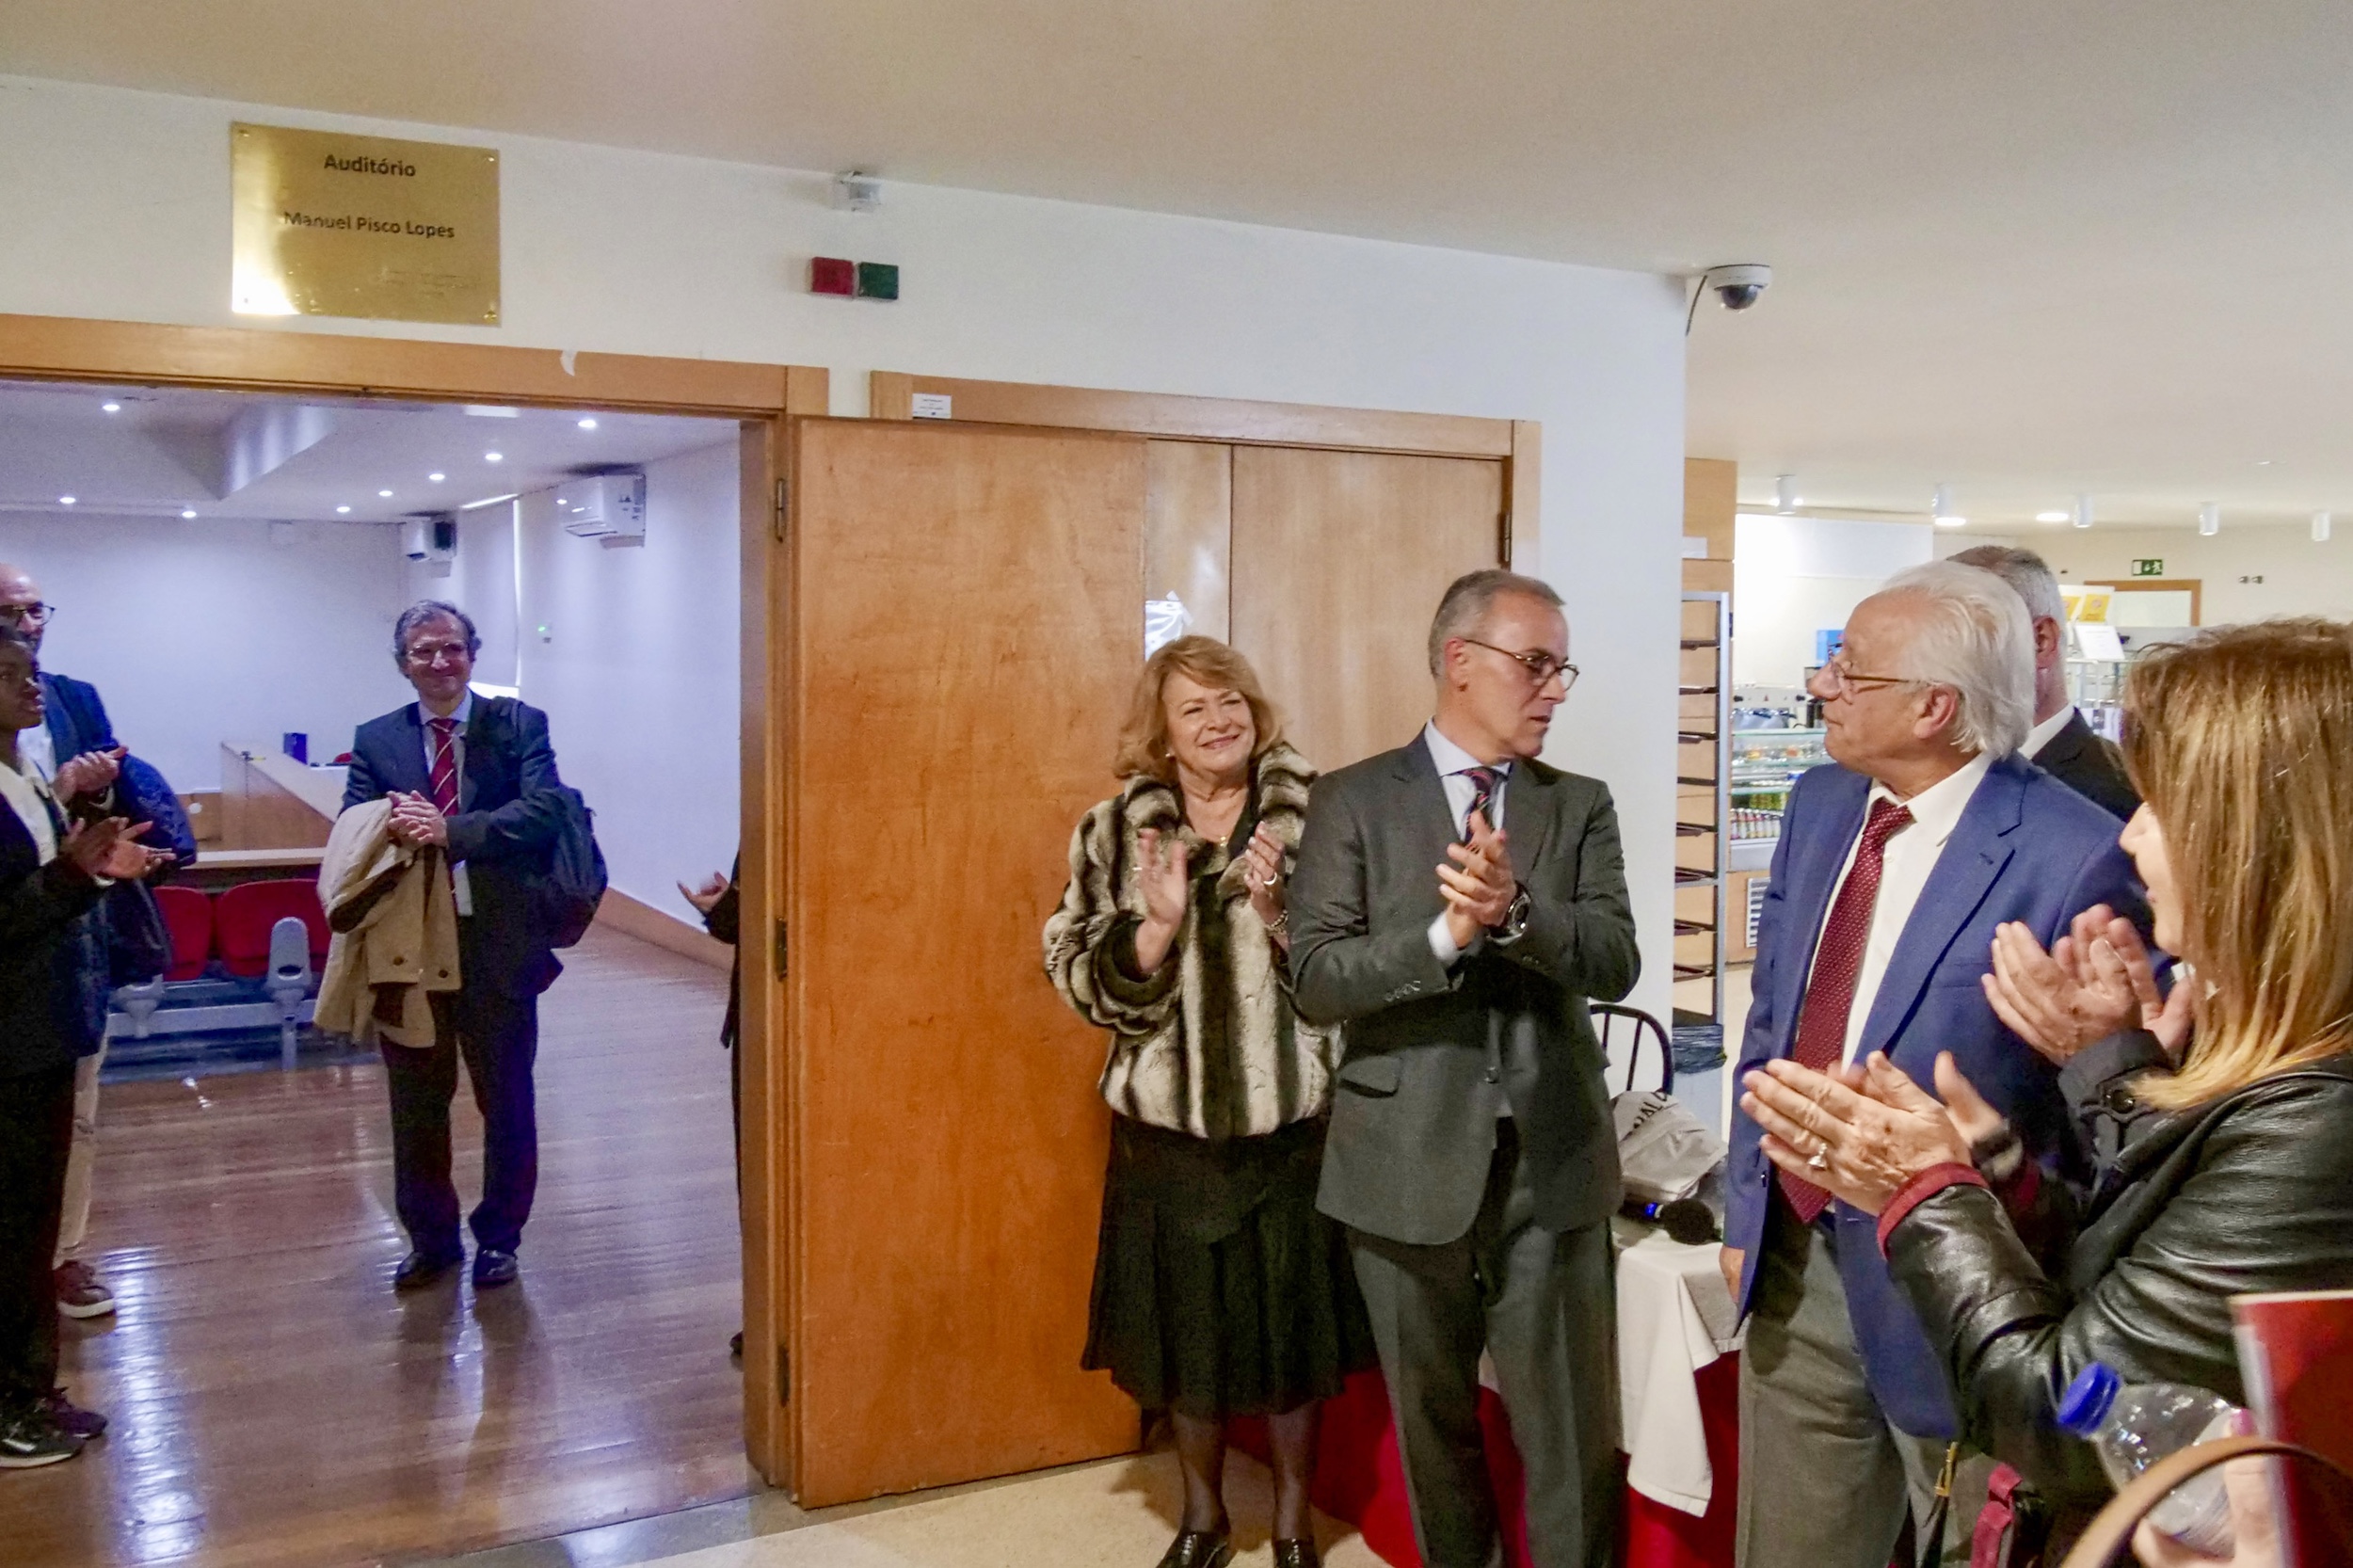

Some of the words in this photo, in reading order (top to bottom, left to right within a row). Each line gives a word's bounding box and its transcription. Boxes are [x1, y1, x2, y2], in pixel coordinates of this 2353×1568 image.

[324, 153, 416, 177] Auditório
[283, 212, 351, 230] Manuel
[356, 216, 401, 233] Pisco
[406, 220, 456, 238] Lopes
